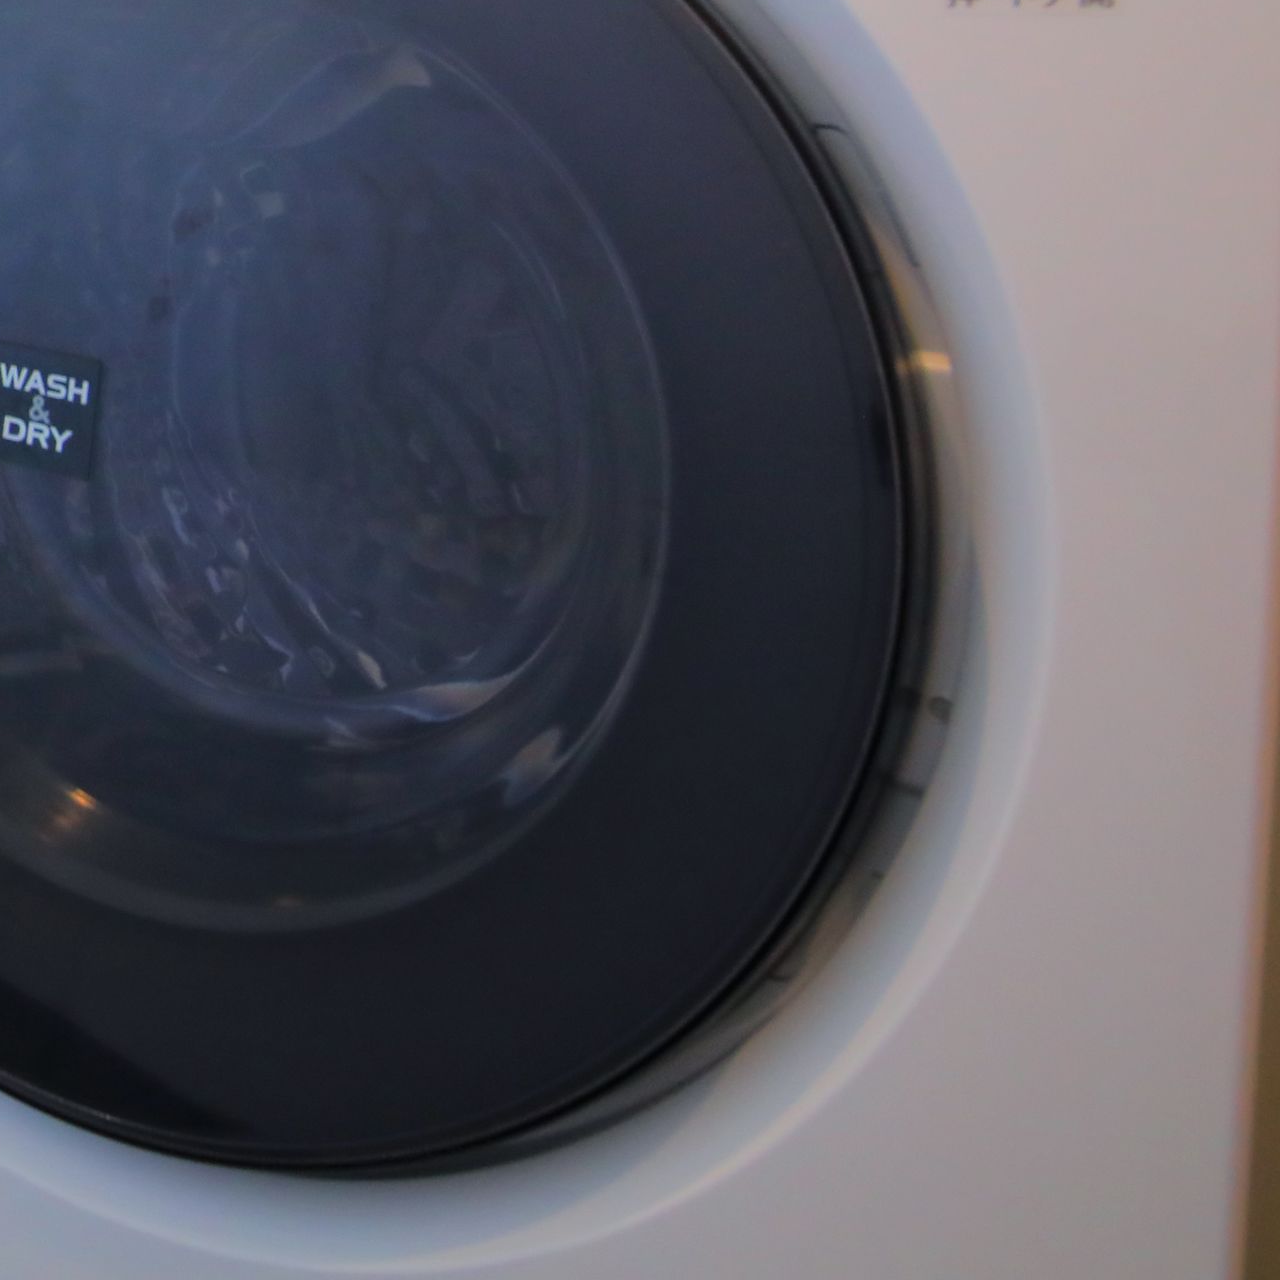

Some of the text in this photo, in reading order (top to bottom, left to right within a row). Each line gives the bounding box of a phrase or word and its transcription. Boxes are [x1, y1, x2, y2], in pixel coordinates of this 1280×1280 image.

[0, 362, 90, 406] WASH
[28, 394, 51, 424] &
[2, 414, 73, 454] DRY
